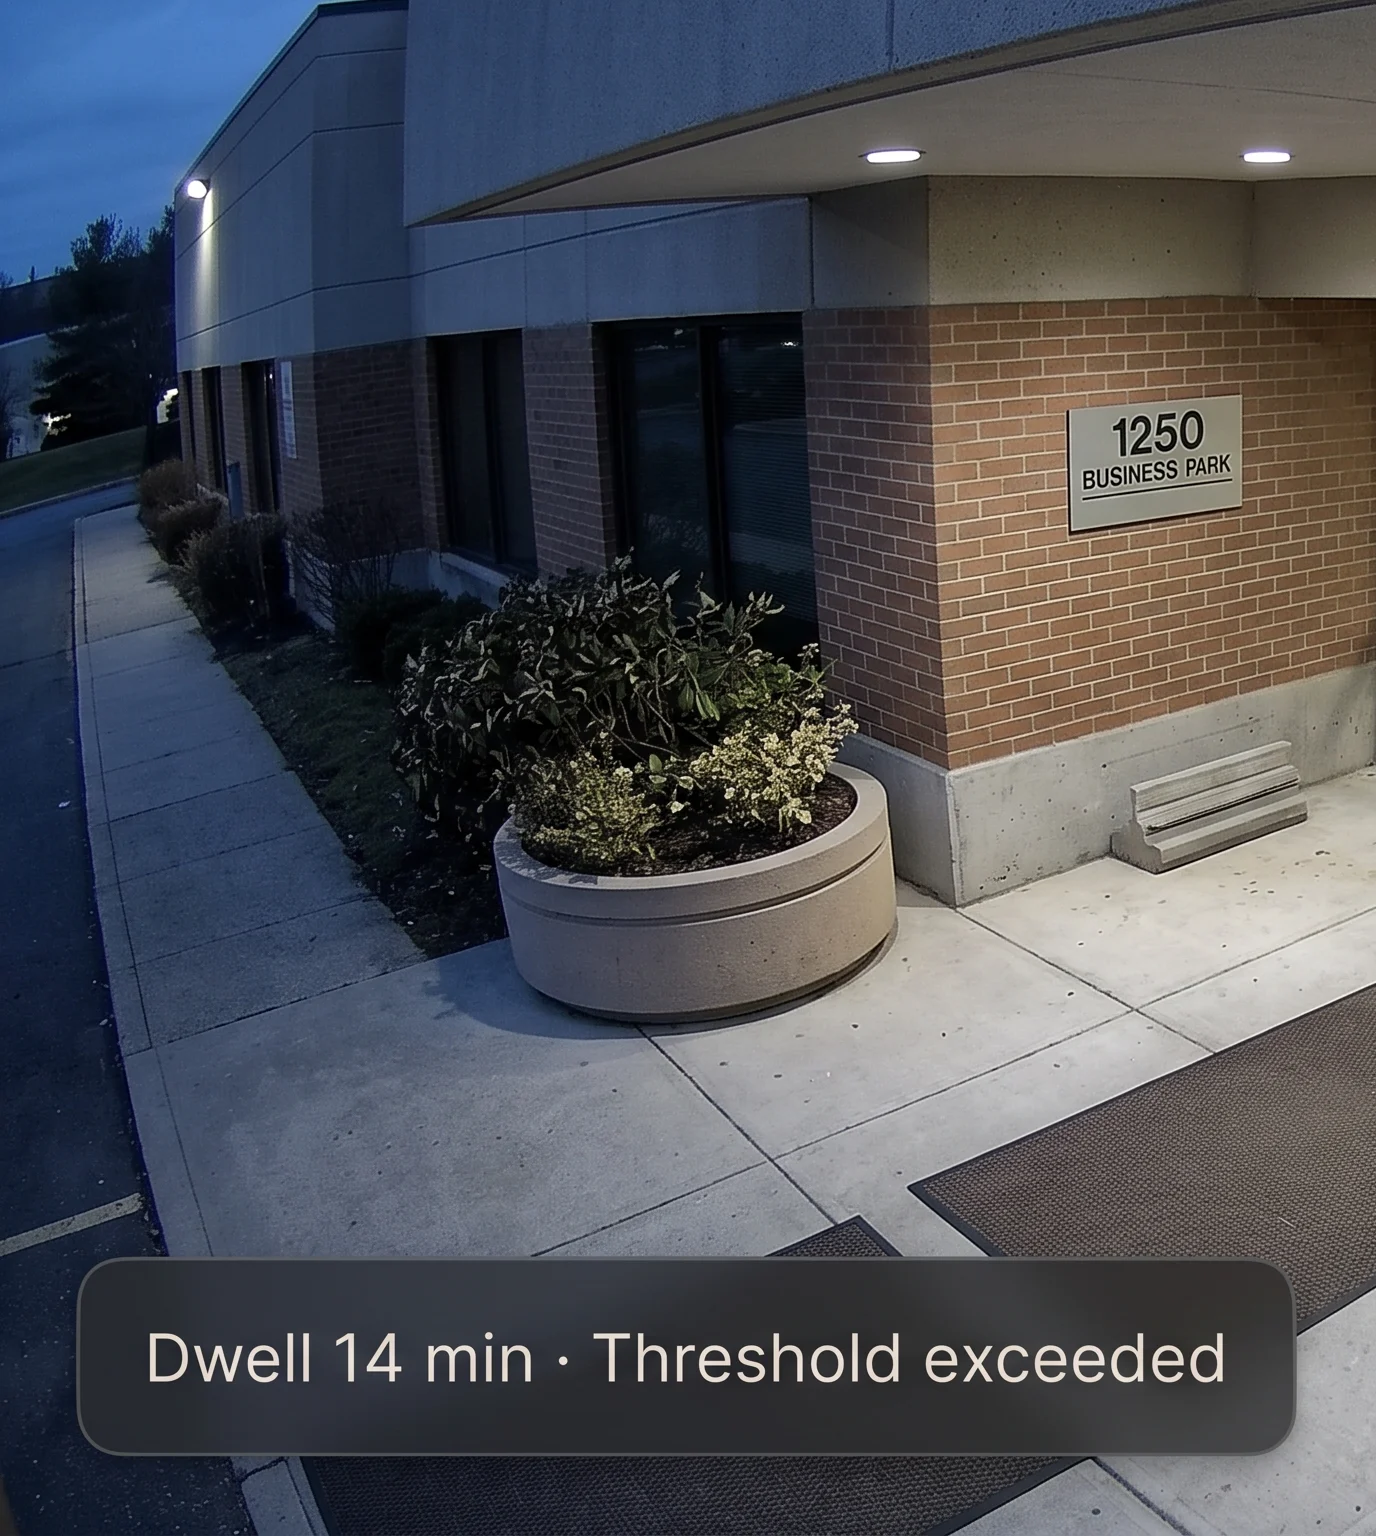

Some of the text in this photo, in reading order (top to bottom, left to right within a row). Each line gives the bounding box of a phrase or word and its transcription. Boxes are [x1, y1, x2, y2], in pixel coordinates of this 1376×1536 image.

[1112, 410, 1204, 457] 1250
[1082, 453, 1231, 490] BUSINESS PARK
